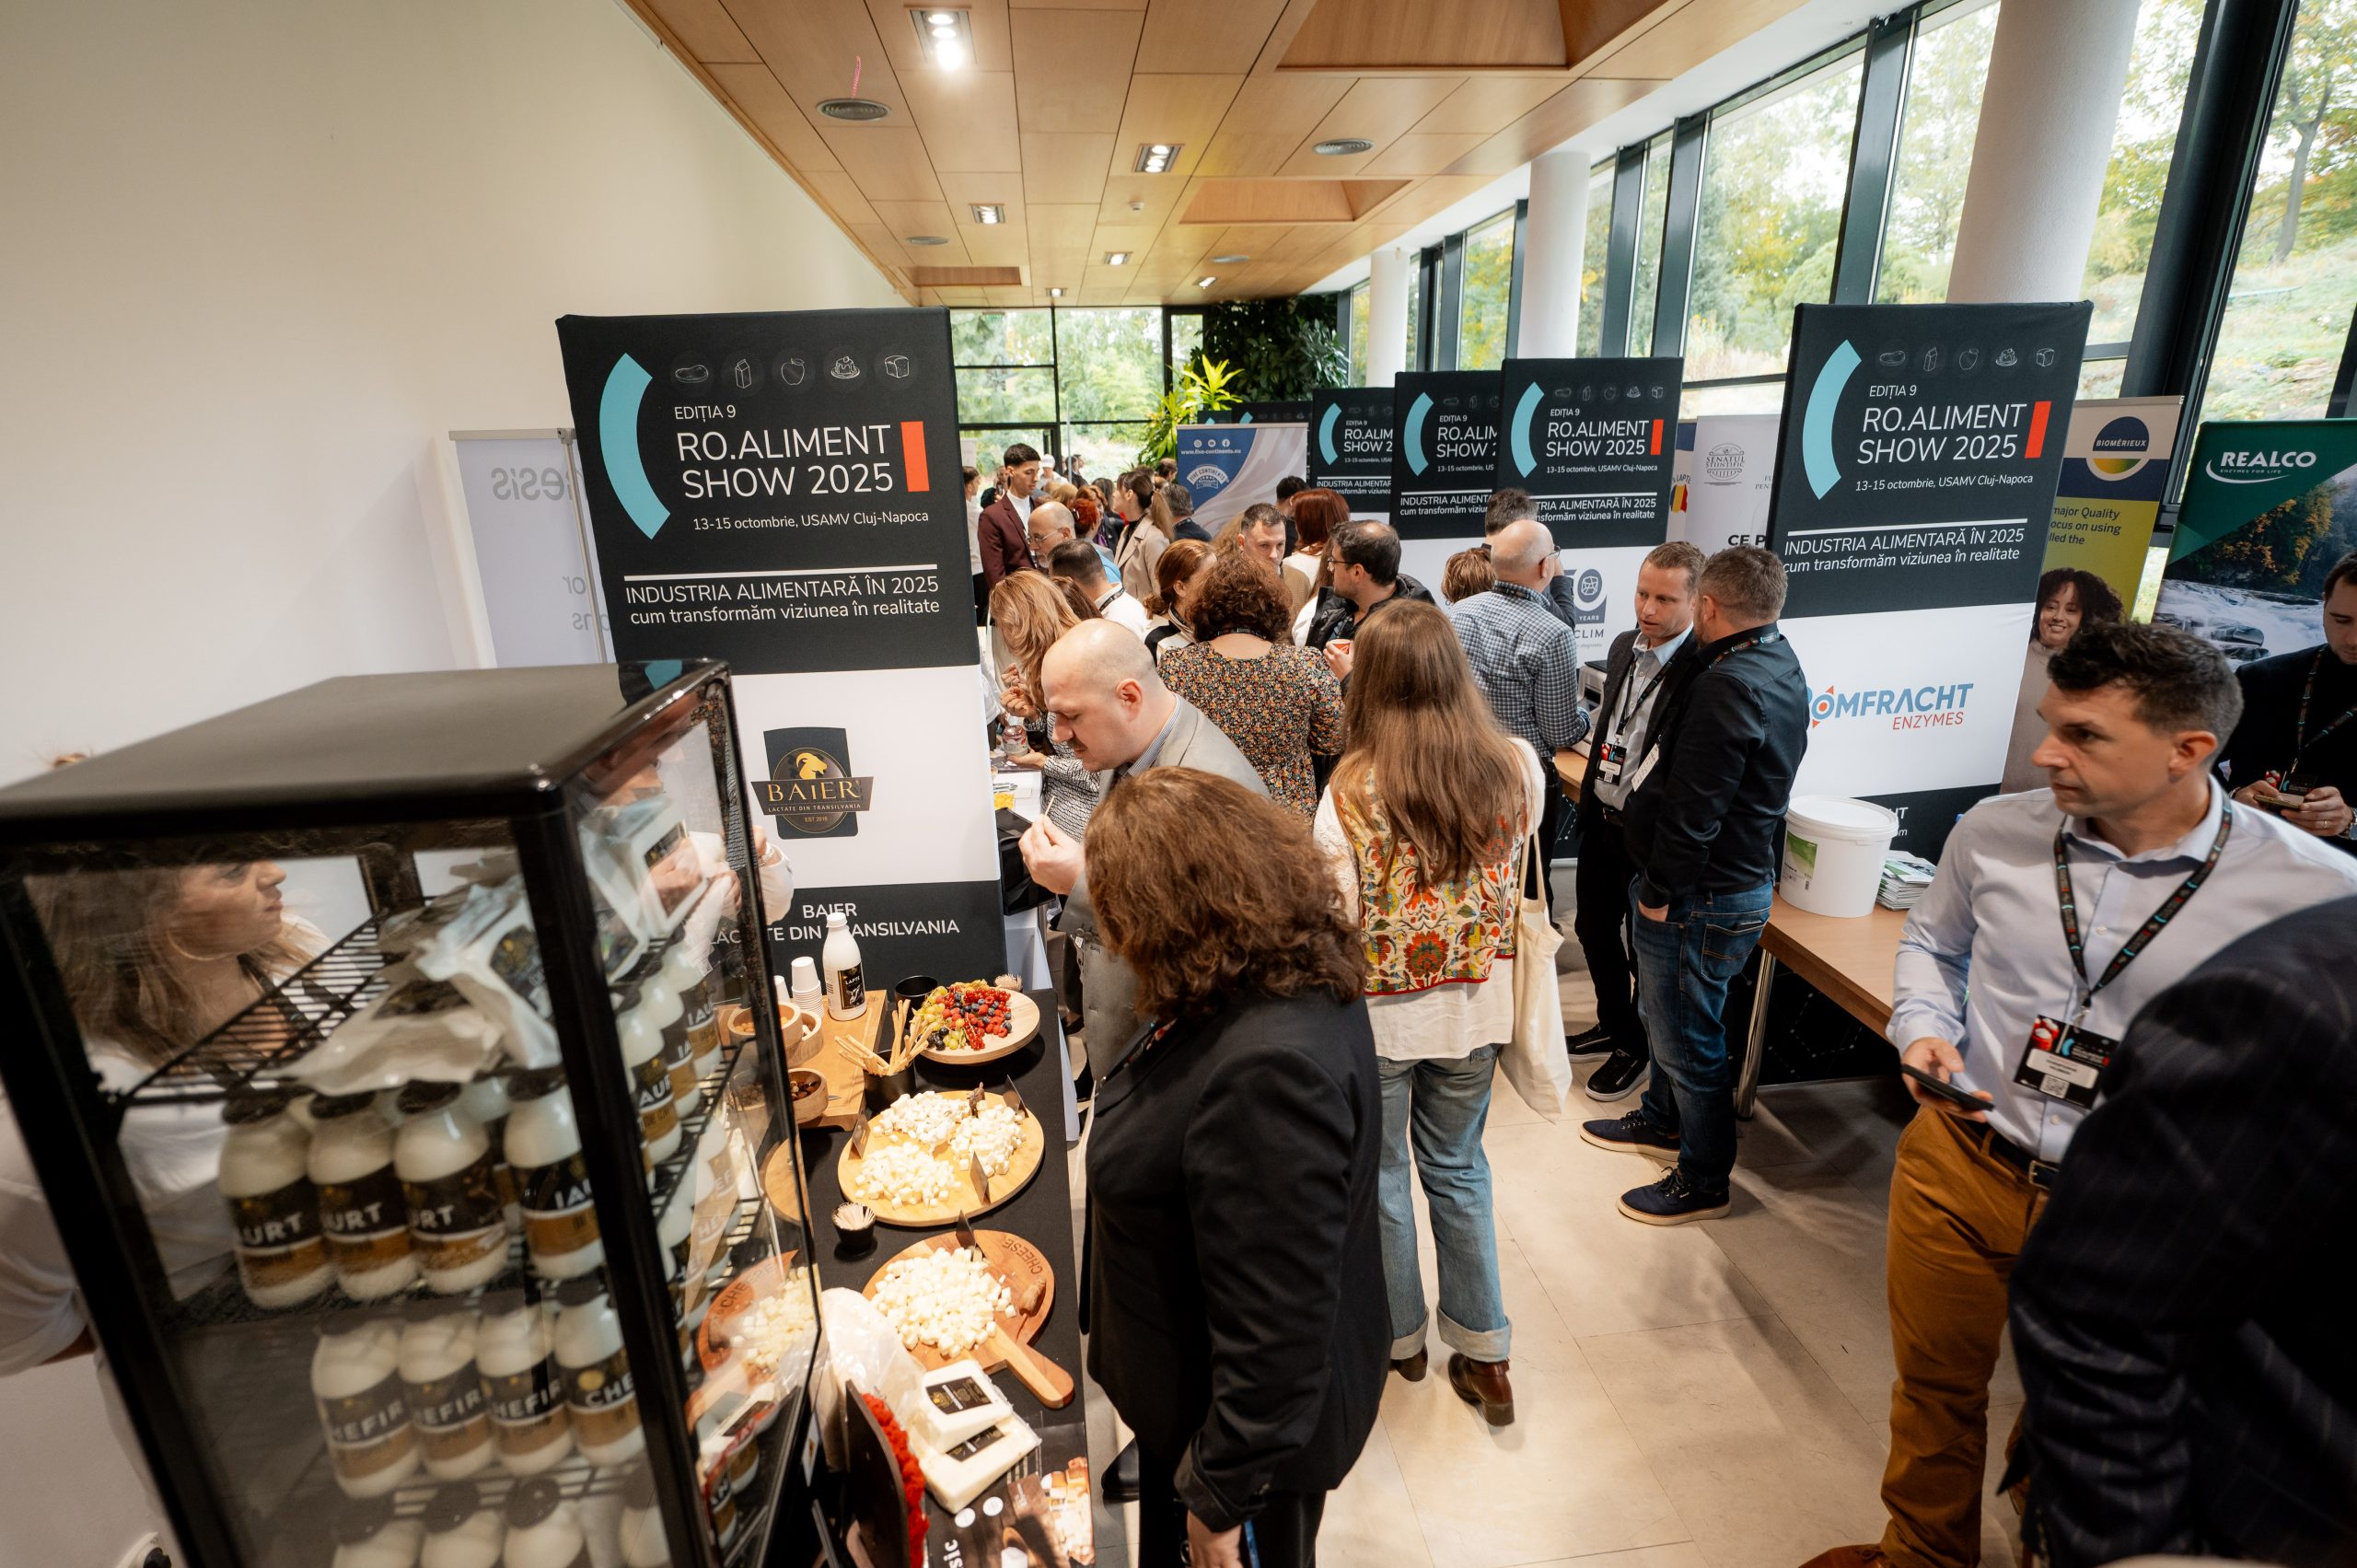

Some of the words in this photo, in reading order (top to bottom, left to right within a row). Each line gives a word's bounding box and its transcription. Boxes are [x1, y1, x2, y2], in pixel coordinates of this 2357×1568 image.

[1869, 385, 1907, 400] EDIȚIA
[1910, 385, 1917, 396] 9
[675, 406, 724, 423] EDIȚIA
[726, 405, 736, 418] 9
[1574, 408, 1580, 416] 9
[1863, 403, 2027, 433] RO.ALIMENT
[1344, 428, 1393, 440] RO.ALIM
[1438, 425, 1498, 441] RO.ALIM
[1548, 420, 1649, 438] RO.ALIMENT
[677, 424, 891, 461] RO.ALIMENT
[1343, 441, 1383, 452] SHOW
[1436, 443, 1488, 458] SHOW
[1546, 440, 1601, 457] SHOW
[1606, 439, 1645, 456] 2025
[1857, 436, 1947, 464] SHOW
[1953, 434, 2018, 460] 2025
[2096, 437, 2147, 447] BIOMÉRIEUX
[2220, 451, 2316, 468] REALCO
[1546, 466, 1565, 474] 13-15
[1566, 465, 1597, 473] octombrie,
[1622, 464, 1658, 473] Cluj-Napoca
[682, 466, 795, 499] SHOW
[810, 462, 893, 494] 2025
[1855, 480, 1886, 492] 13-15
[1887, 478, 1935, 490] octombrie,
[1938, 475, 1976, 487] USAMV
[1978, 473, 2033, 486] Cluj-Napoca
[1400, 496, 1448, 506] INDUSTRIA
[1450, 494, 1490, 505] ALIMENT
[1559, 497, 1620, 511] ALIMENTARĂ
[1621, 496, 1632, 508] ÎN
[1633, 498, 1656, 508] 2025
[1400, 507, 1416, 516] cum
[1418, 506, 1467, 515] transformăm
[1536, 510, 1576, 522] nsformăm
[1578, 510, 1611, 520] viziunea
[1613, 510, 1621, 520] în
[1622, 509, 1655, 519] realitate
[2081, 507, 2119, 521] Quality
[693, 517, 731, 530] 13-15
[734, 515, 798, 529] octombrie,
[801, 512, 850, 527] USAMV
[853, 510, 929, 527] Cluj-Napoca
[2050, 519, 2073, 530] ocus
[2075, 521, 2089, 530] on
[2091, 522, 2121, 536] using
[1727, 534, 1750, 546] CE
[1784, 539, 1867, 555] INDUSTRIA
[1870, 529, 1966, 551] ALIMENTARĂ
[1970, 527, 1986, 545] ÎN
[1989, 528, 2025, 543] 2025
[2068, 533, 2084, 545] the
[1782, 561, 1810, 574] cum
[1813, 554, 1896, 572] transformăm
[1899, 552, 1951, 567] viziunea
[1954, 551, 1968, 563] în
[1969, 548, 2020, 562] realitate
[626, 584, 731, 604] INDUSTRIA
[737, 576, 863, 600] ALIMENTARĂ
[866, 575, 887, 596] ÎN
[891, 575, 939, 594] 2025
[631, 610, 666, 625] cum
[669, 603, 777, 623] transformăm
[780, 601, 849, 619] viziunea
[852, 599, 868, 616] în
[873, 598, 940, 615] realitate
[1574, 629, 1604, 639] CLIM
[1807, 683, 1974, 721] OMFRACHT
[1893, 712, 1964, 730] ENZYMES
[767, 781, 862, 802] BAIER
[789, 925, 822, 941] DIN
[849, 919, 959, 938] ANSILVANIA
[1002, 1238, 1043, 1274] CHEESE
